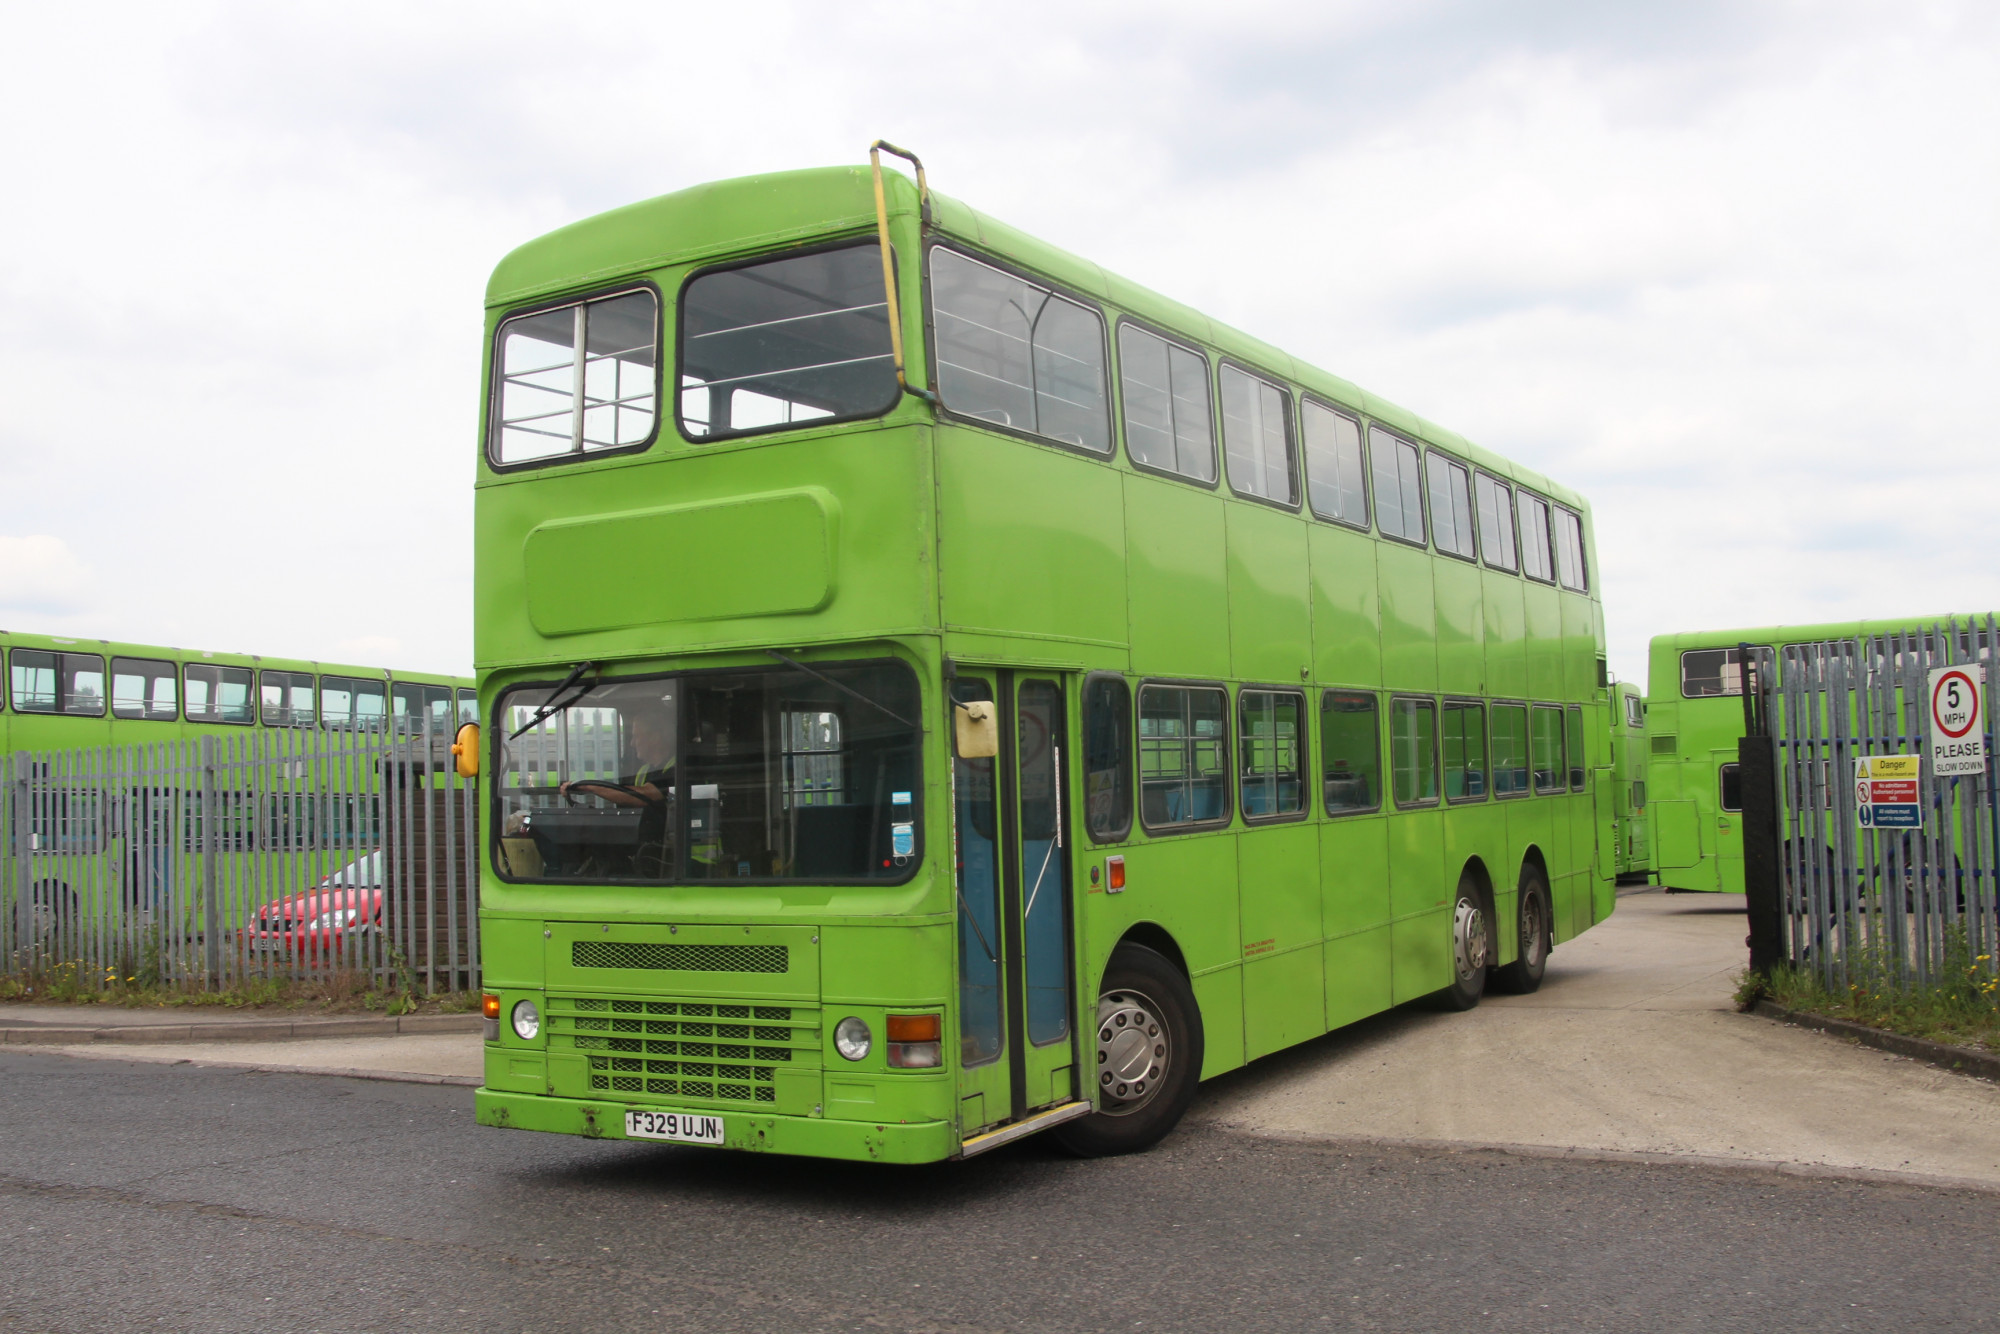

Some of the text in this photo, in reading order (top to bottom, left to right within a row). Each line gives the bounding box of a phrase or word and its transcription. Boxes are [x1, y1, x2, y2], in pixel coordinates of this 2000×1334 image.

[1947, 681, 1960, 708] 5
[1944, 712, 1966, 725] MPH
[1935, 742, 1980, 759] PLEASE
[1880, 760, 1906, 770] Danger
[1936, 761, 1983, 772] SLOW DOWN
[632, 1112, 717, 1138] F329 UJN
